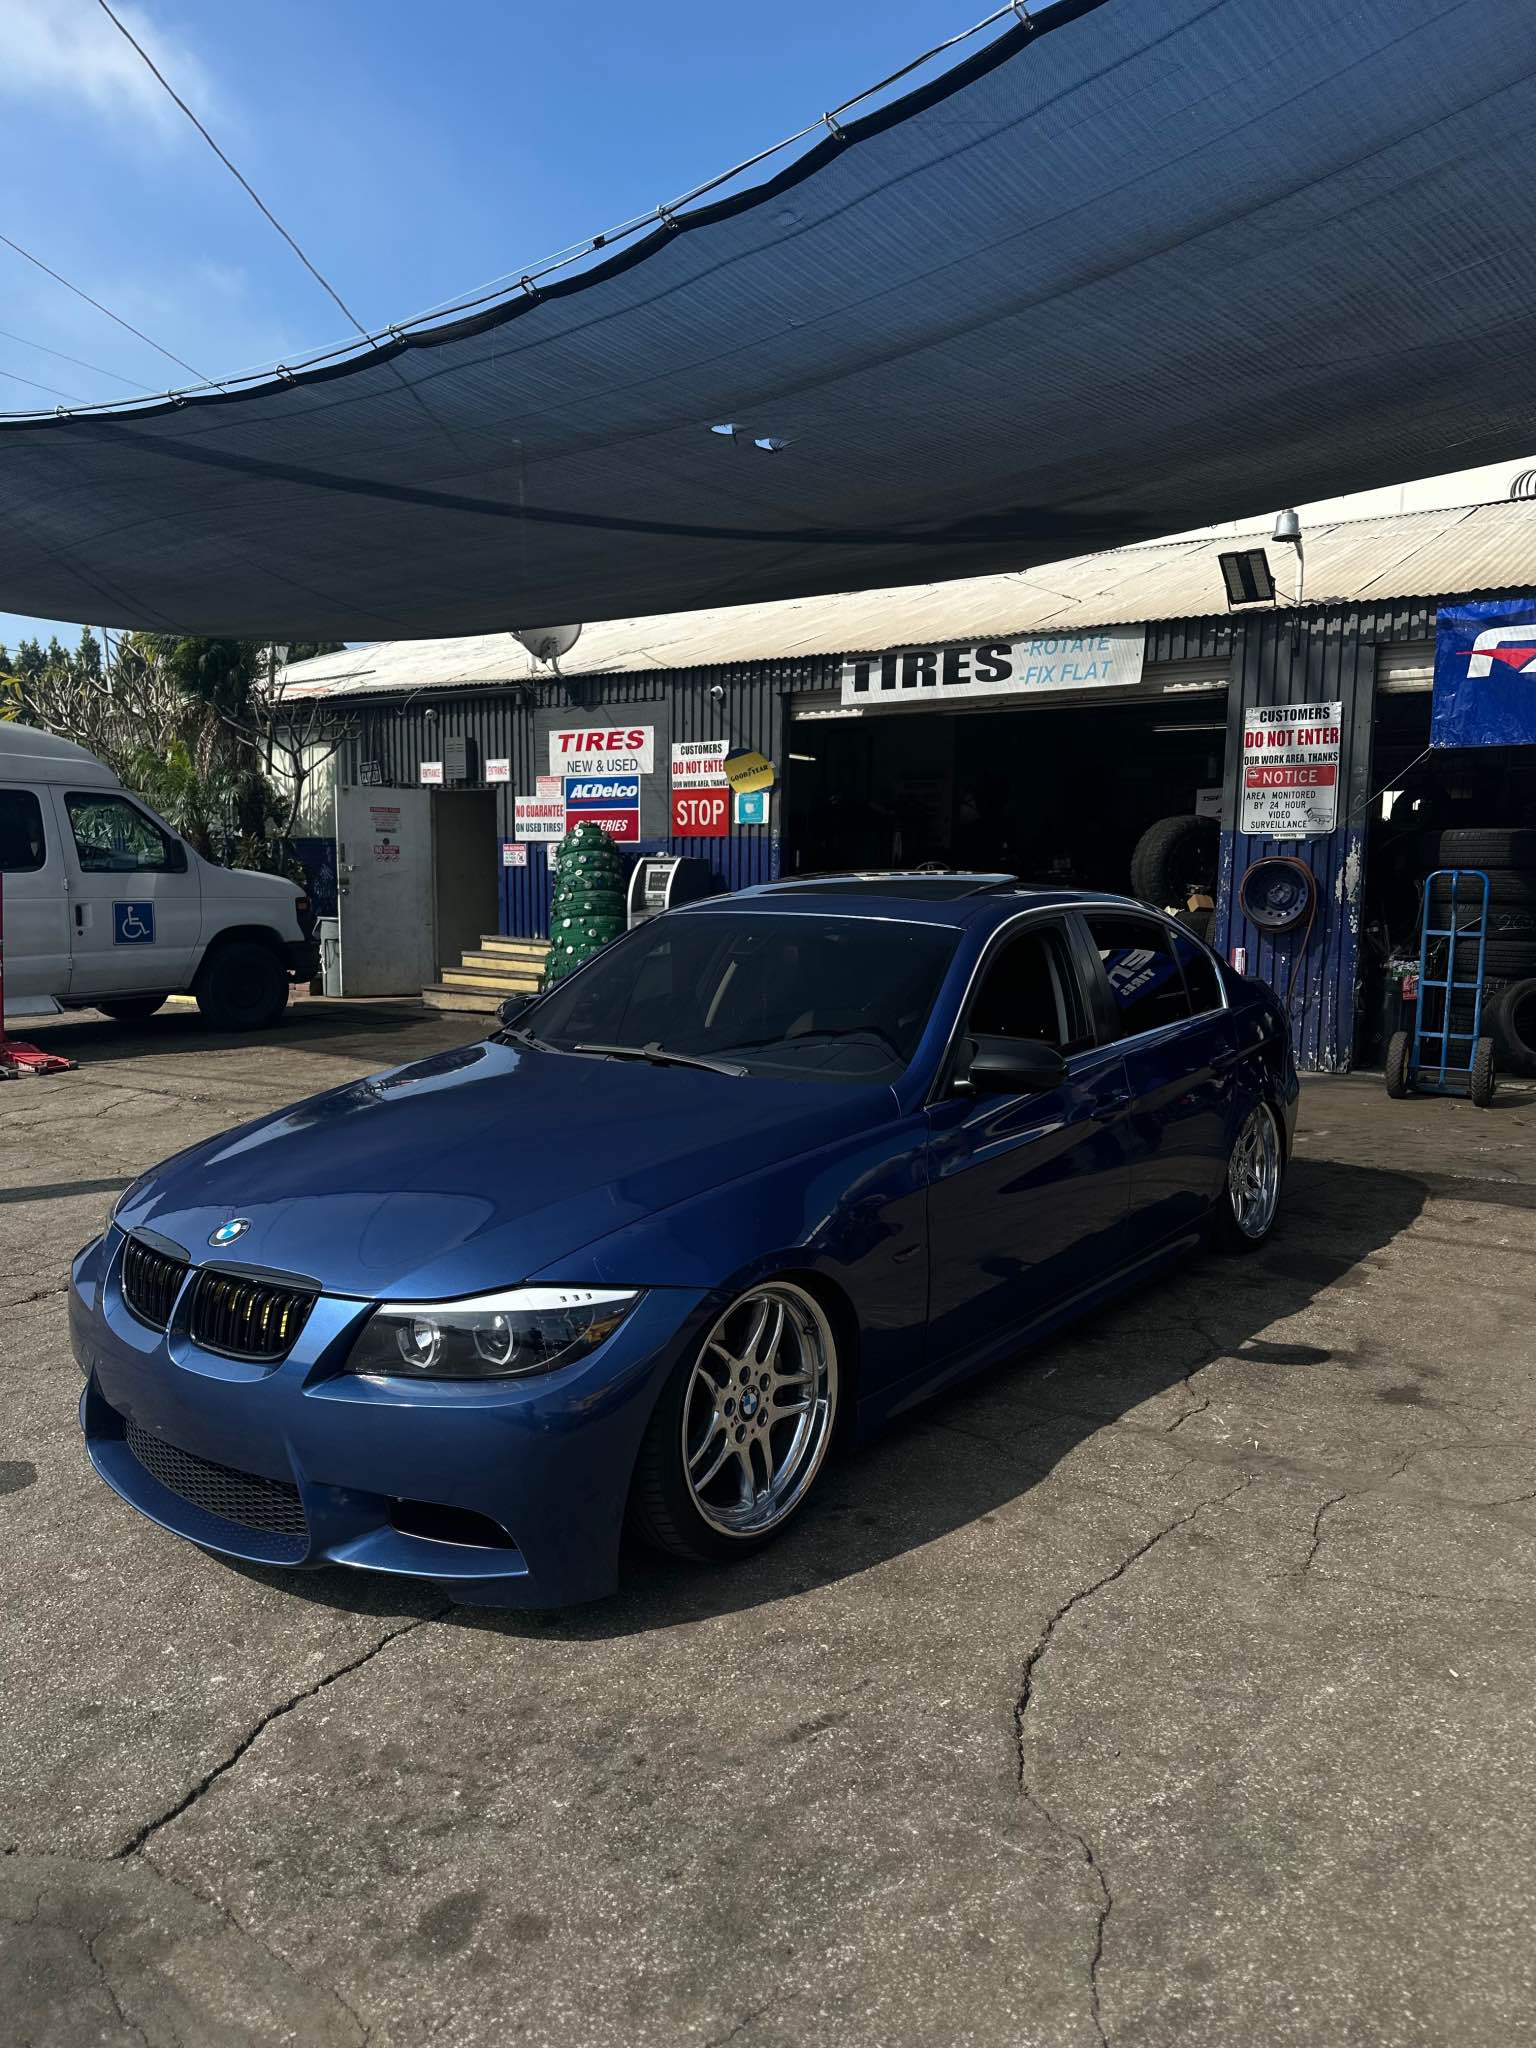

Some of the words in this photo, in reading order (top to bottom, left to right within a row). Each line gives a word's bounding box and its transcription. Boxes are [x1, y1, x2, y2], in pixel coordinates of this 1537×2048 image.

[847, 643, 1013, 692] TIRES
[1060, 660, 1112, 682] FLAT
[1260, 707, 1330, 722] CUSTOMERS
[558, 730, 645, 752] TIRES
[1245, 732, 1264, 748] DO
[1267, 730, 1294, 747] NOT
[1297, 727, 1339, 745] ENTER
[681, 744, 722, 755] CUSTOMERS
[567, 760, 593, 772] NEW
[596, 759, 604, 772] &
[607, 758, 638, 771] USED
[1244, 756, 1260, 765] OUR
[1261, 754, 1284, 764] WORK
[1308, 752, 1338, 762] THANKS
[673, 762, 684, 774] DO
[686, 761, 702, 774] NOT
[730, 764, 768, 782] GOODYEAR
[1262, 769, 1318, 784] NOTICE
[570, 783, 638, 798] ACDelco
[1246, 792, 1266, 800] AREA
[1272, 791, 1316, 799] MONITORED
[516, 805, 525, 817] NO
[526, 804, 564, 817] GUARANTEE
[1254, 801, 1264, 809] BY
[1270, 801, 1279, 809] 24
[1285, 801, 1306, 809] HOUR
[677, 799, 724, 826] STOP
[1268, 811, 1291, 819] VIDEO
[516, 823, 525, 832] ON
[526, 823, 542, 832] USED
[543, 823, 564, 832] TIRES!
[1251, 820, 1307, 829] SURVEILLANCE
